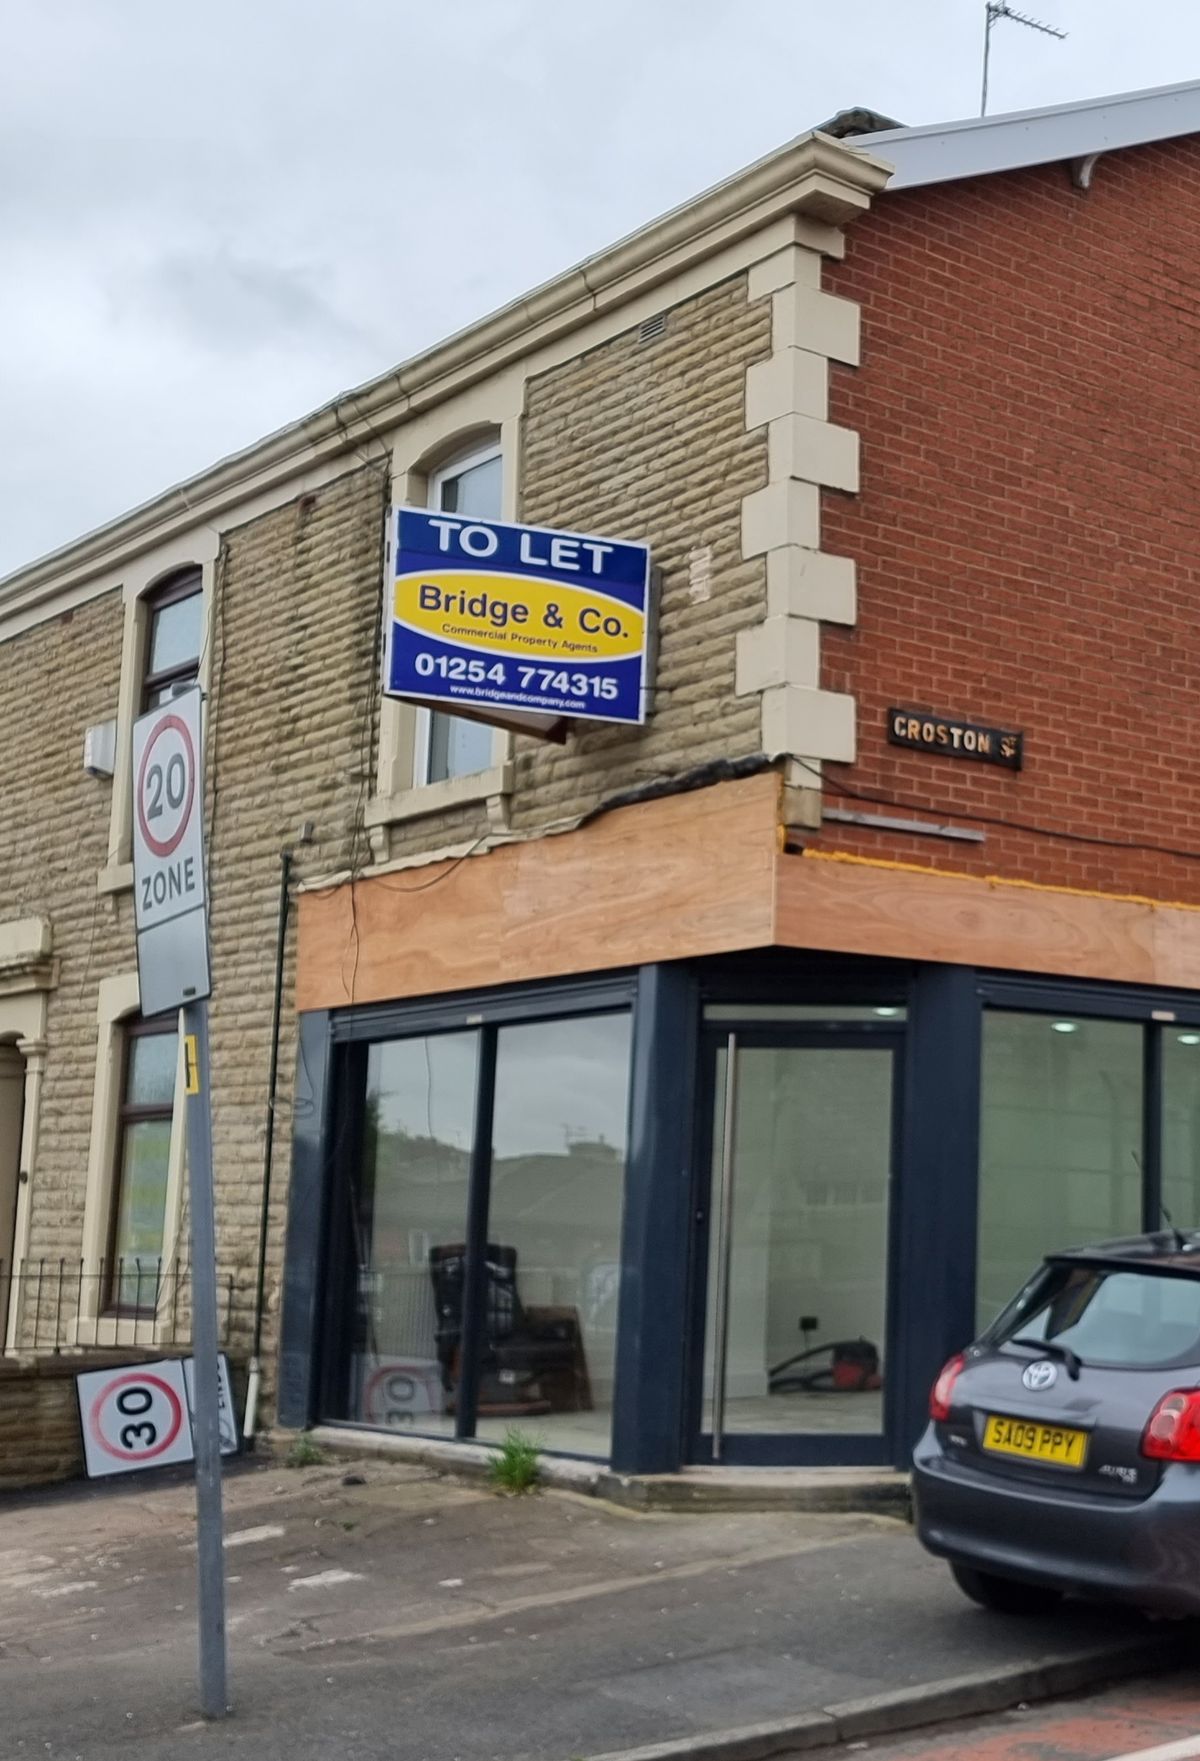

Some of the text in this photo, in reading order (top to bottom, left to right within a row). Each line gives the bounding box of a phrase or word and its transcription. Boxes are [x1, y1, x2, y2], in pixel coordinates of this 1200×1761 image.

[428, 518, 614, 574] TO LET
[419, 584, 629, 639] Bridge & Co.
[442, 623, 598, 653] Commercial Property Agents
[415, 652, 618, 699] 01254 774315
[450, 685, 586, 709] www.bridgeandcompany.com
[894, 716, 992, 754] CROSTON
[146, 752, 186, 822] 20
[142, 856, 196, 912] ZONE
[116, 1386, 157, 1450] 30
[993, 1420, 1037, 1450] SA09
[1038, 1429, 1076, 1458] PPY
